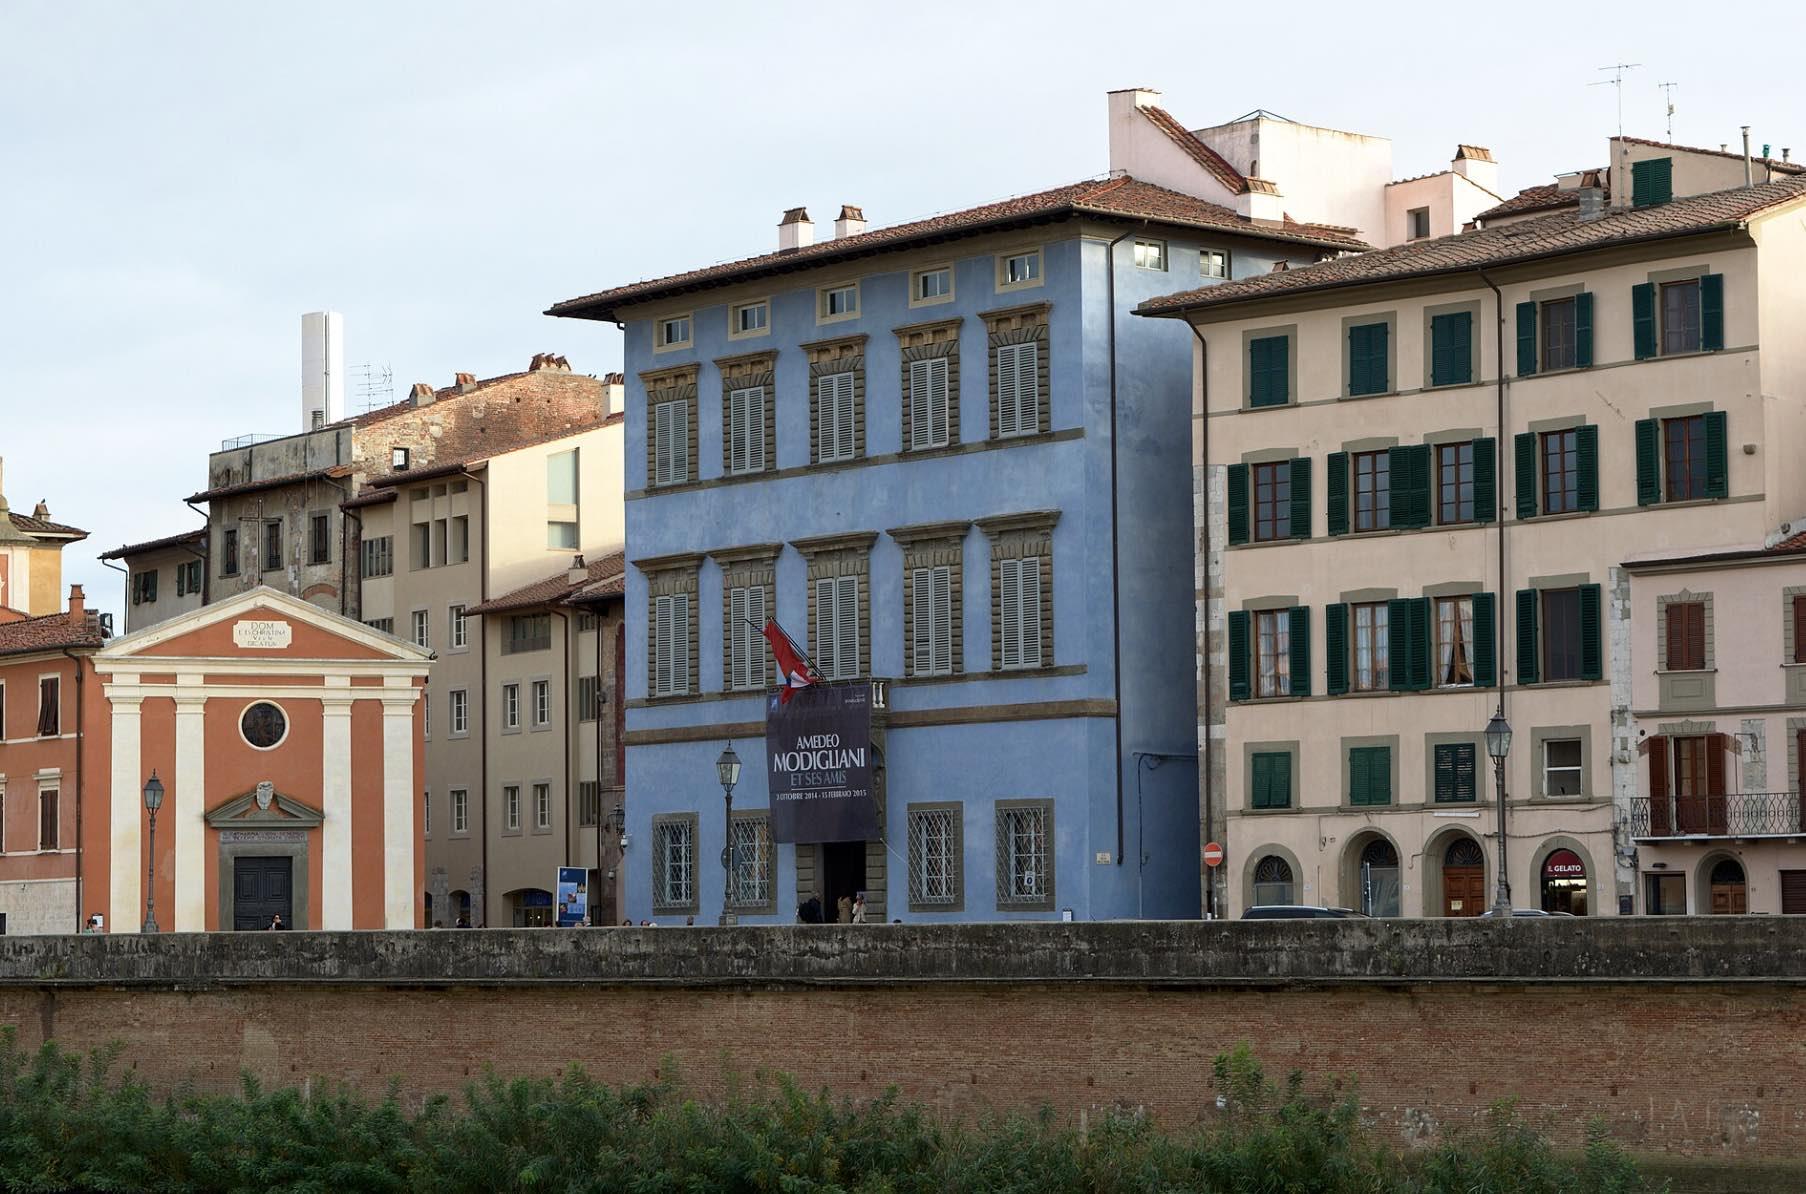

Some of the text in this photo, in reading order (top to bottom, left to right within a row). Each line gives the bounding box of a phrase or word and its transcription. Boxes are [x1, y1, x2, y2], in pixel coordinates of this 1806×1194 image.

[796, 733, 840, 750] AMEDEO
[774, 747, 865, 772] MODIGLIANI
[791, 770, 847, 786] ET SES AMIS
[780, 792, 804, 801] OTTOBRE
[805, 791, 818, 800] 2014
[853, 789, 867, 797] 2015
